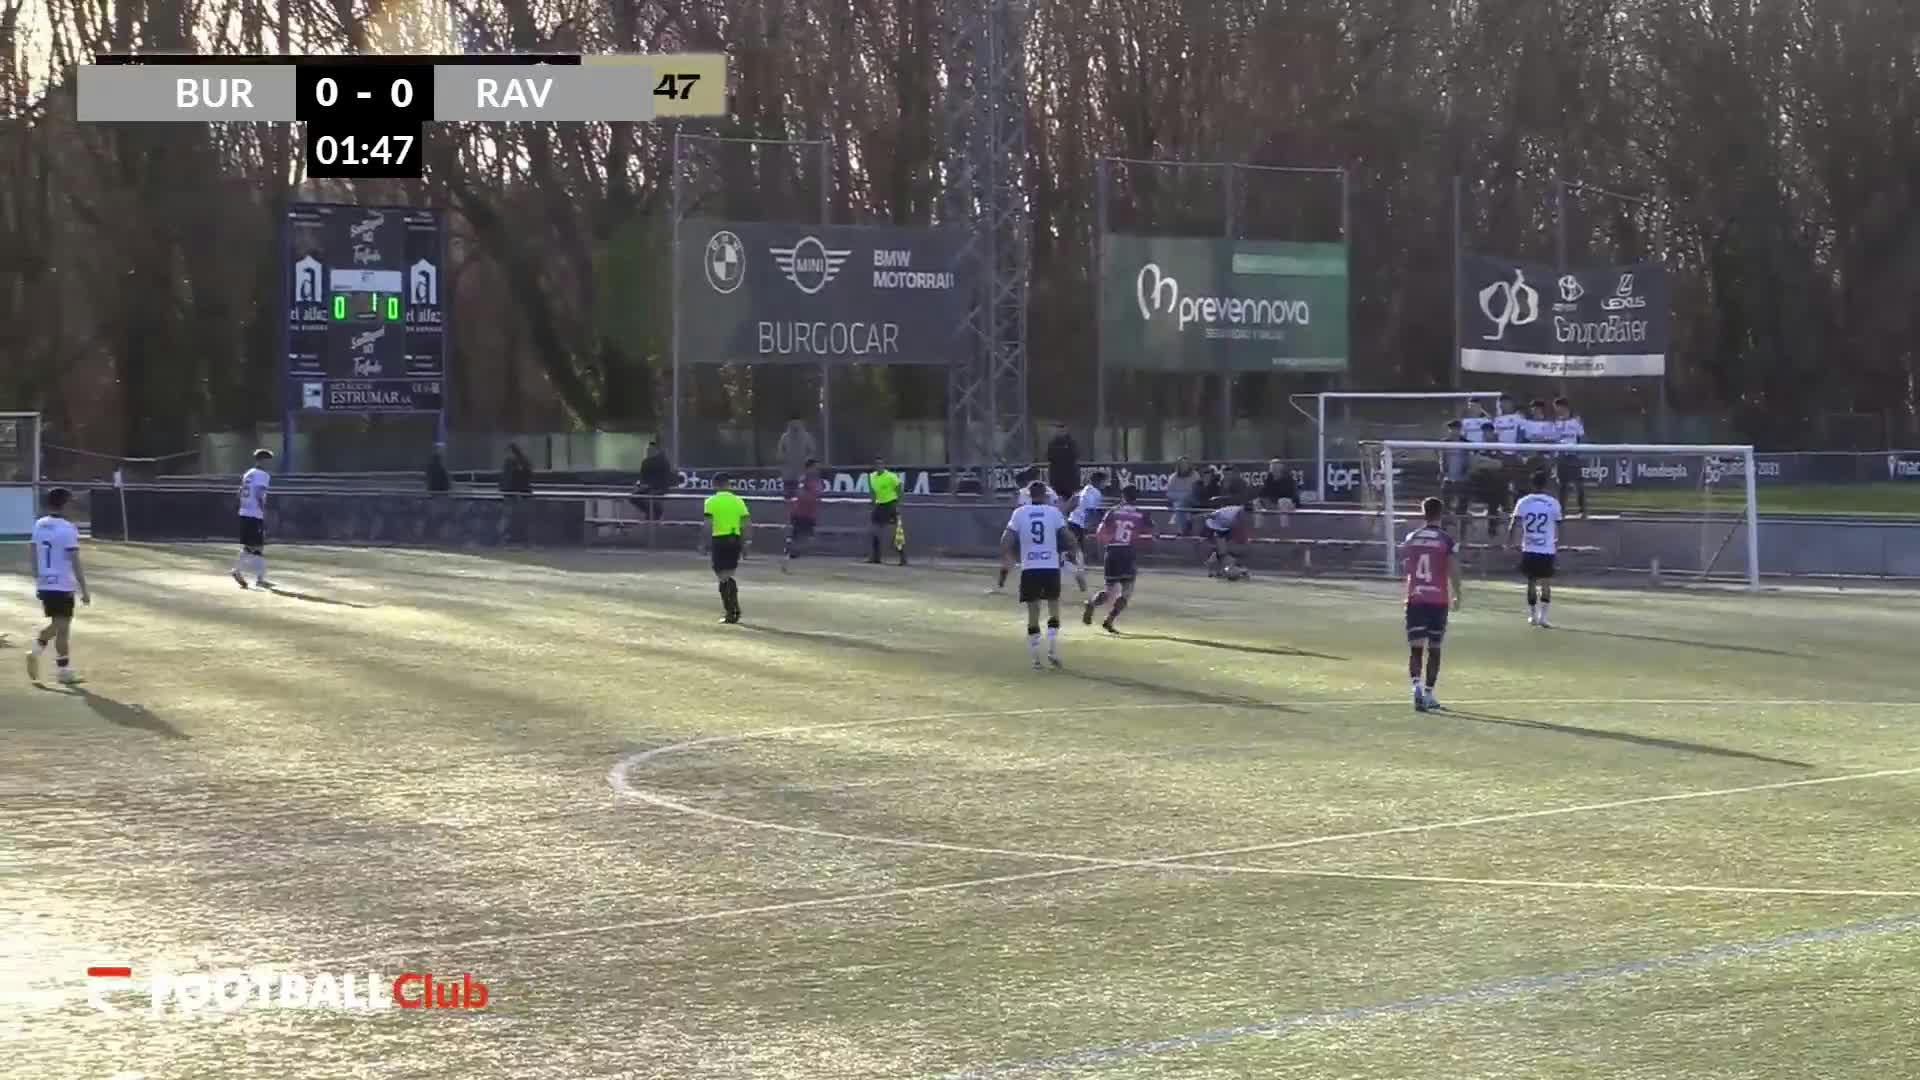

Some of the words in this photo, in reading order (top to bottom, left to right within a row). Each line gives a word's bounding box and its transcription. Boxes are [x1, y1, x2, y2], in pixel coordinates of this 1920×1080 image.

[796, 259, 824, 274] MINI
[873, 250, 911, 267] BMW
[334, 295, 345, 320] 0
[387, 296, 399, 320] 0
[1178, 297, 1310, 331] prevennova
[758, 321, 899, 355] BURGOCAR
[1030, 519, 1046, 545] 9
[1525, 513, 1549, 534] 22
[41, 540, 53, 569] 7
[1415, 553, 1433, 583] 4
